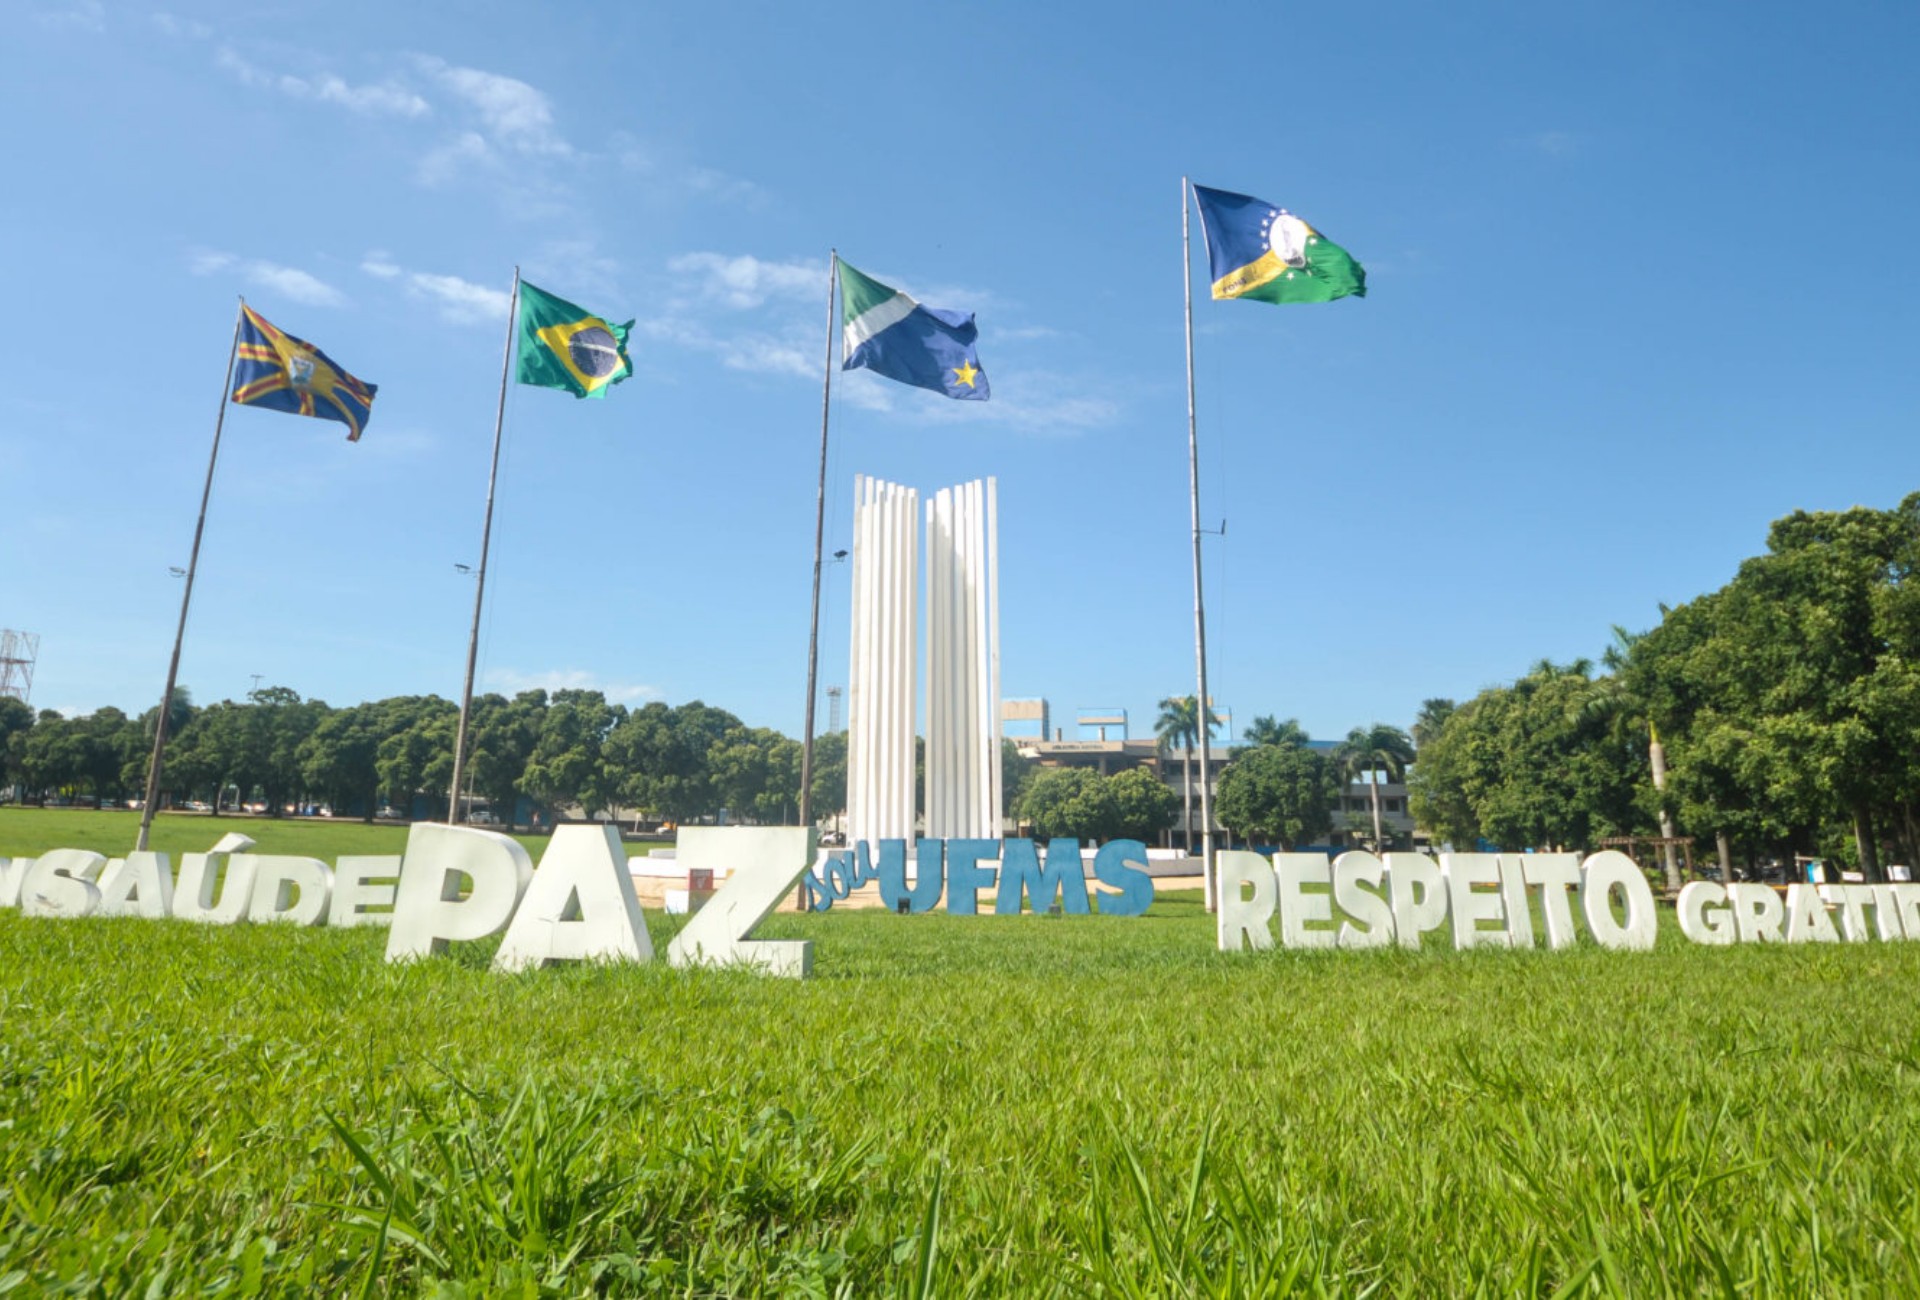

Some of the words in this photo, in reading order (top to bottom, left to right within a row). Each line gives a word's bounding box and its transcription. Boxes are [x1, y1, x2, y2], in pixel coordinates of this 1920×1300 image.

[21, 832, 402, 927] SAÚDE
[385, 821, 818, 980] PAZ
[879, 837, 1154, 916] UFMS
[1215, 850, 1658, 952] RESPEITO
